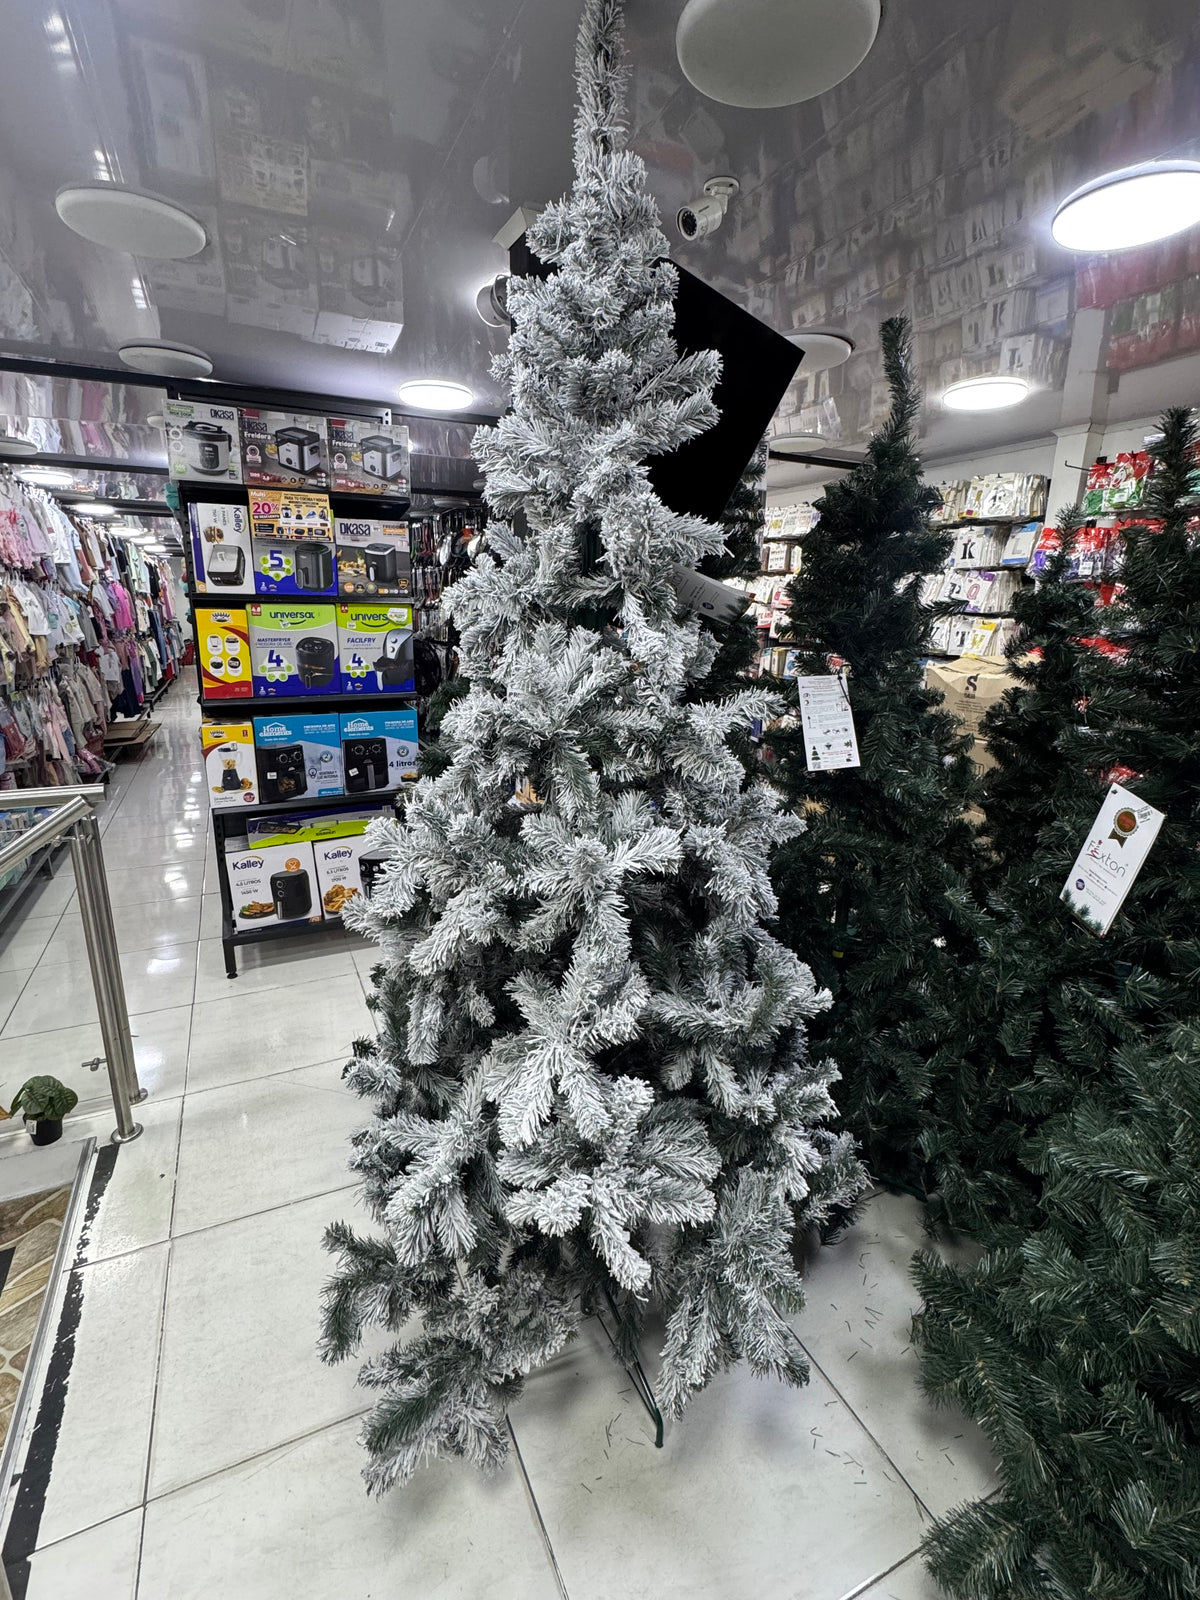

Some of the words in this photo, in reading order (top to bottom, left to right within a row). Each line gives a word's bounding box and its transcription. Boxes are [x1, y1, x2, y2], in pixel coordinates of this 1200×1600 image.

[244, 431, 271, 440] Freidora
[332, 440, 357, 448] Freidora
[233, 507, 242, 533] Kalley
[269, 549, 283, 568] 5
[269, 611, 315, 619] universal
[351, 613, 388, 621] univers
[268, 649, 283, 667] 4
[352, 653, 363, 667] 4
[324, 849, 353, 860] Kalley
[232, 859, 264, 871] Kalley
